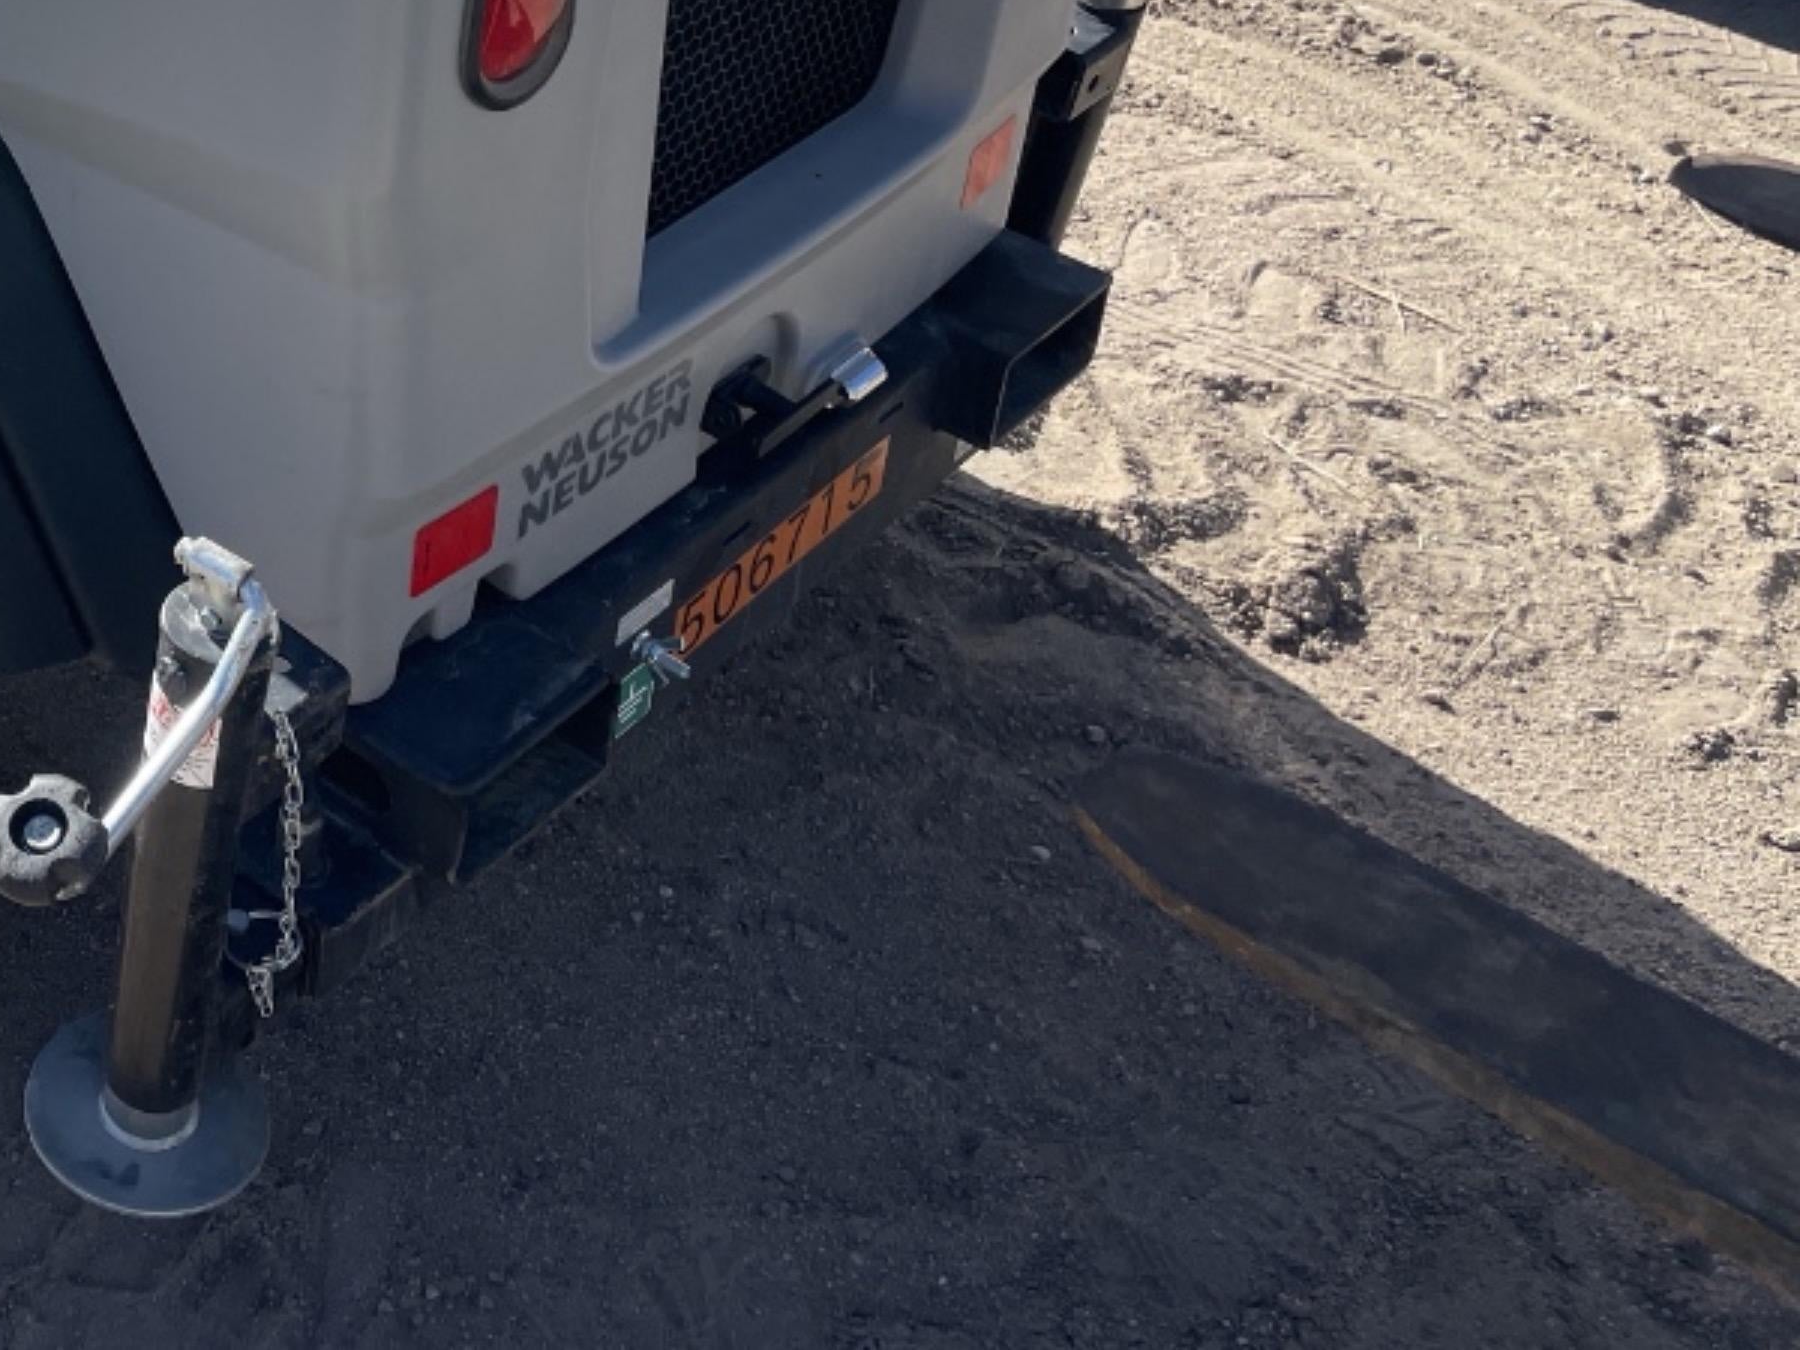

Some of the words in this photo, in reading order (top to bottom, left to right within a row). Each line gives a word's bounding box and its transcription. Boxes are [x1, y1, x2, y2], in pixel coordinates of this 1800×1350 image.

[516, 394, 690, 539] NEUSON
[520, 358, 694, 493] WACKER
[674, 461, 873, 653] 506715
